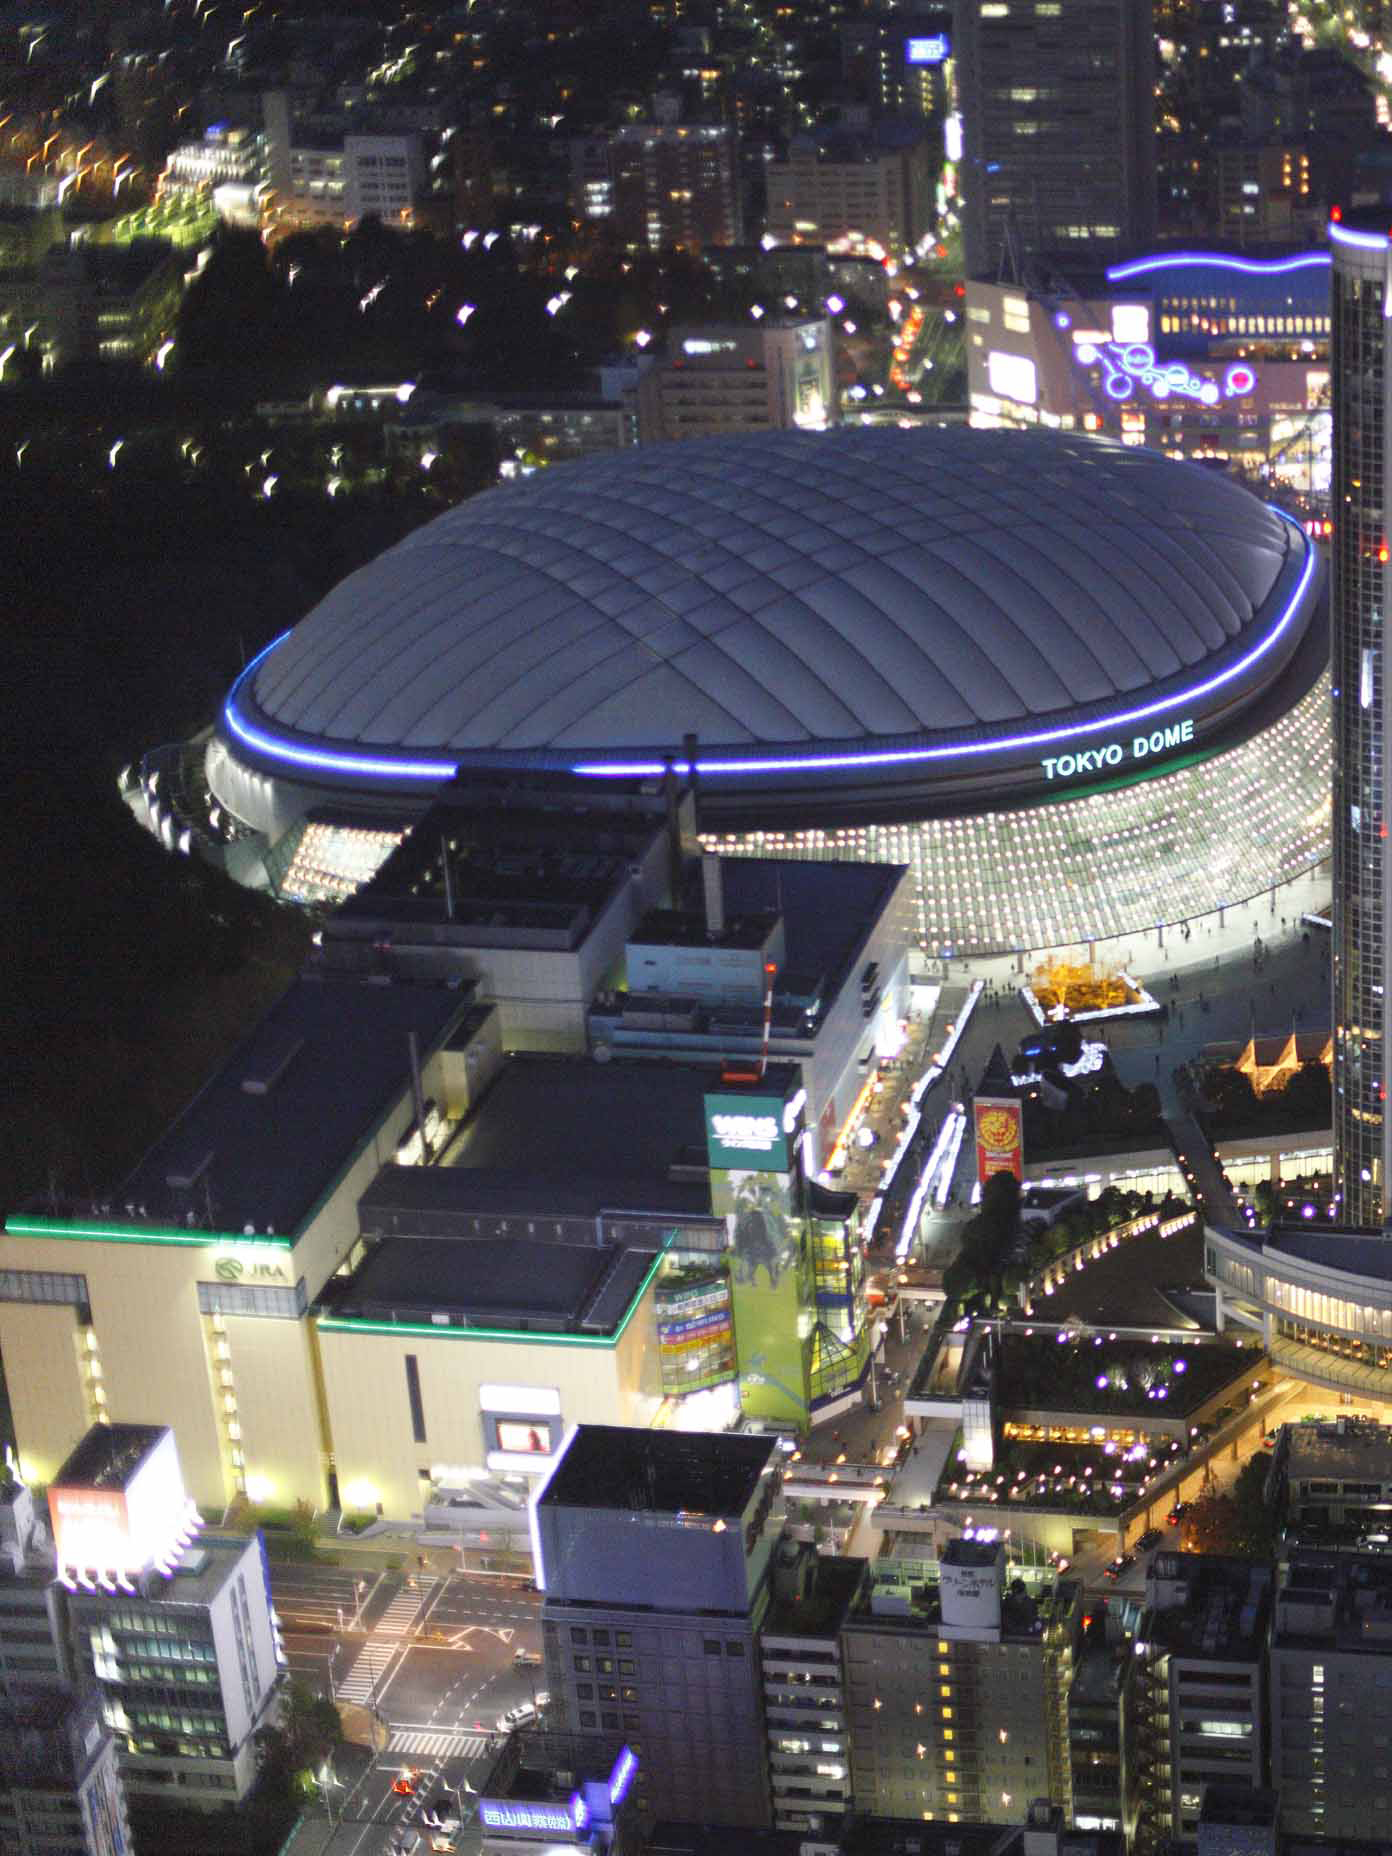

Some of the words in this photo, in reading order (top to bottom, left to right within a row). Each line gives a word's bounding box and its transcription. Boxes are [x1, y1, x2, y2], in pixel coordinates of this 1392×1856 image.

[1041, 744, 1123, 779] TOKYO
[1133, 719, 1194, 758] DOME
[250, 1263, 286, 1278] JRA
